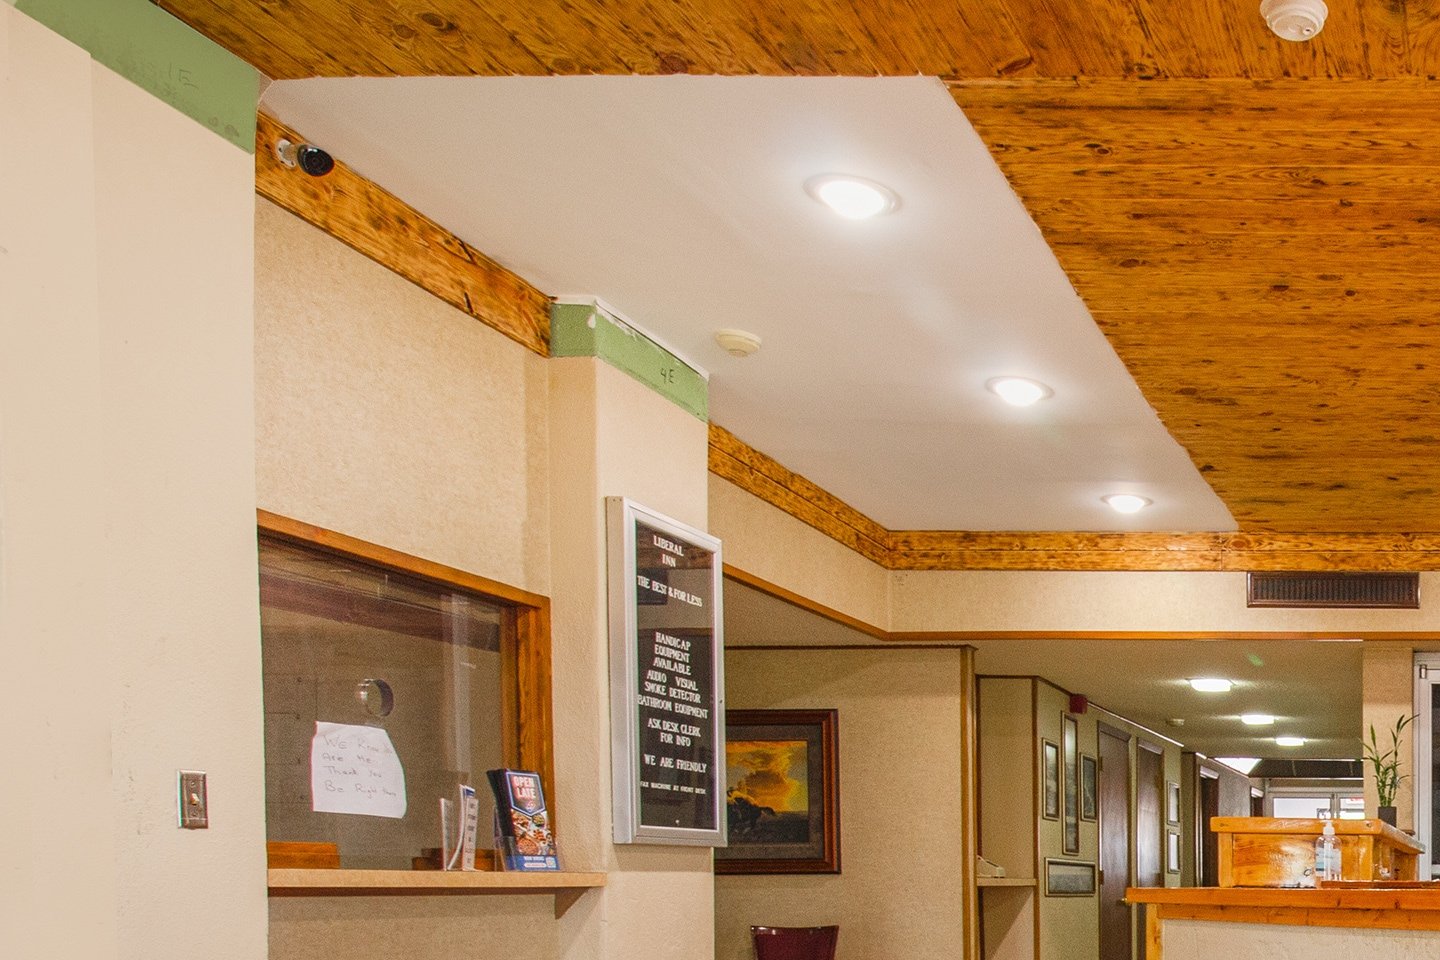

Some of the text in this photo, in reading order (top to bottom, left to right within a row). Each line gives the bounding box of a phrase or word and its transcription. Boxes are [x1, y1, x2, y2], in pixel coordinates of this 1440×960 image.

[660, 368, 674, 384] 4E
[653, 535, 684, 556] LIBERAL
[661, 554, 676, 567] INN
[637, 575, 703, 607] THE BEST & FOR LESS
[655, 632, 691, 651] HANDICAP
[654, 644, 690, 663] EQUIPMENT
[653, 657, 691, 675] AVAILABLE
[646, 670, 698, 691] AUDIO VISUAL
[644, 681, 701, 703] SMOKE DETECTOR
[637, 694, 708, 719] BATHROOM EQUIPMENT
[647, 718, 701, 737] ASK DESK CLERK
[660, 732, 691, 747] FOR INFO
[644, 754, 707, 773] WE ARE FRIENDLY
[513, 775, 535, 788] OPEN
[516, 787, 536, 799] LATE
